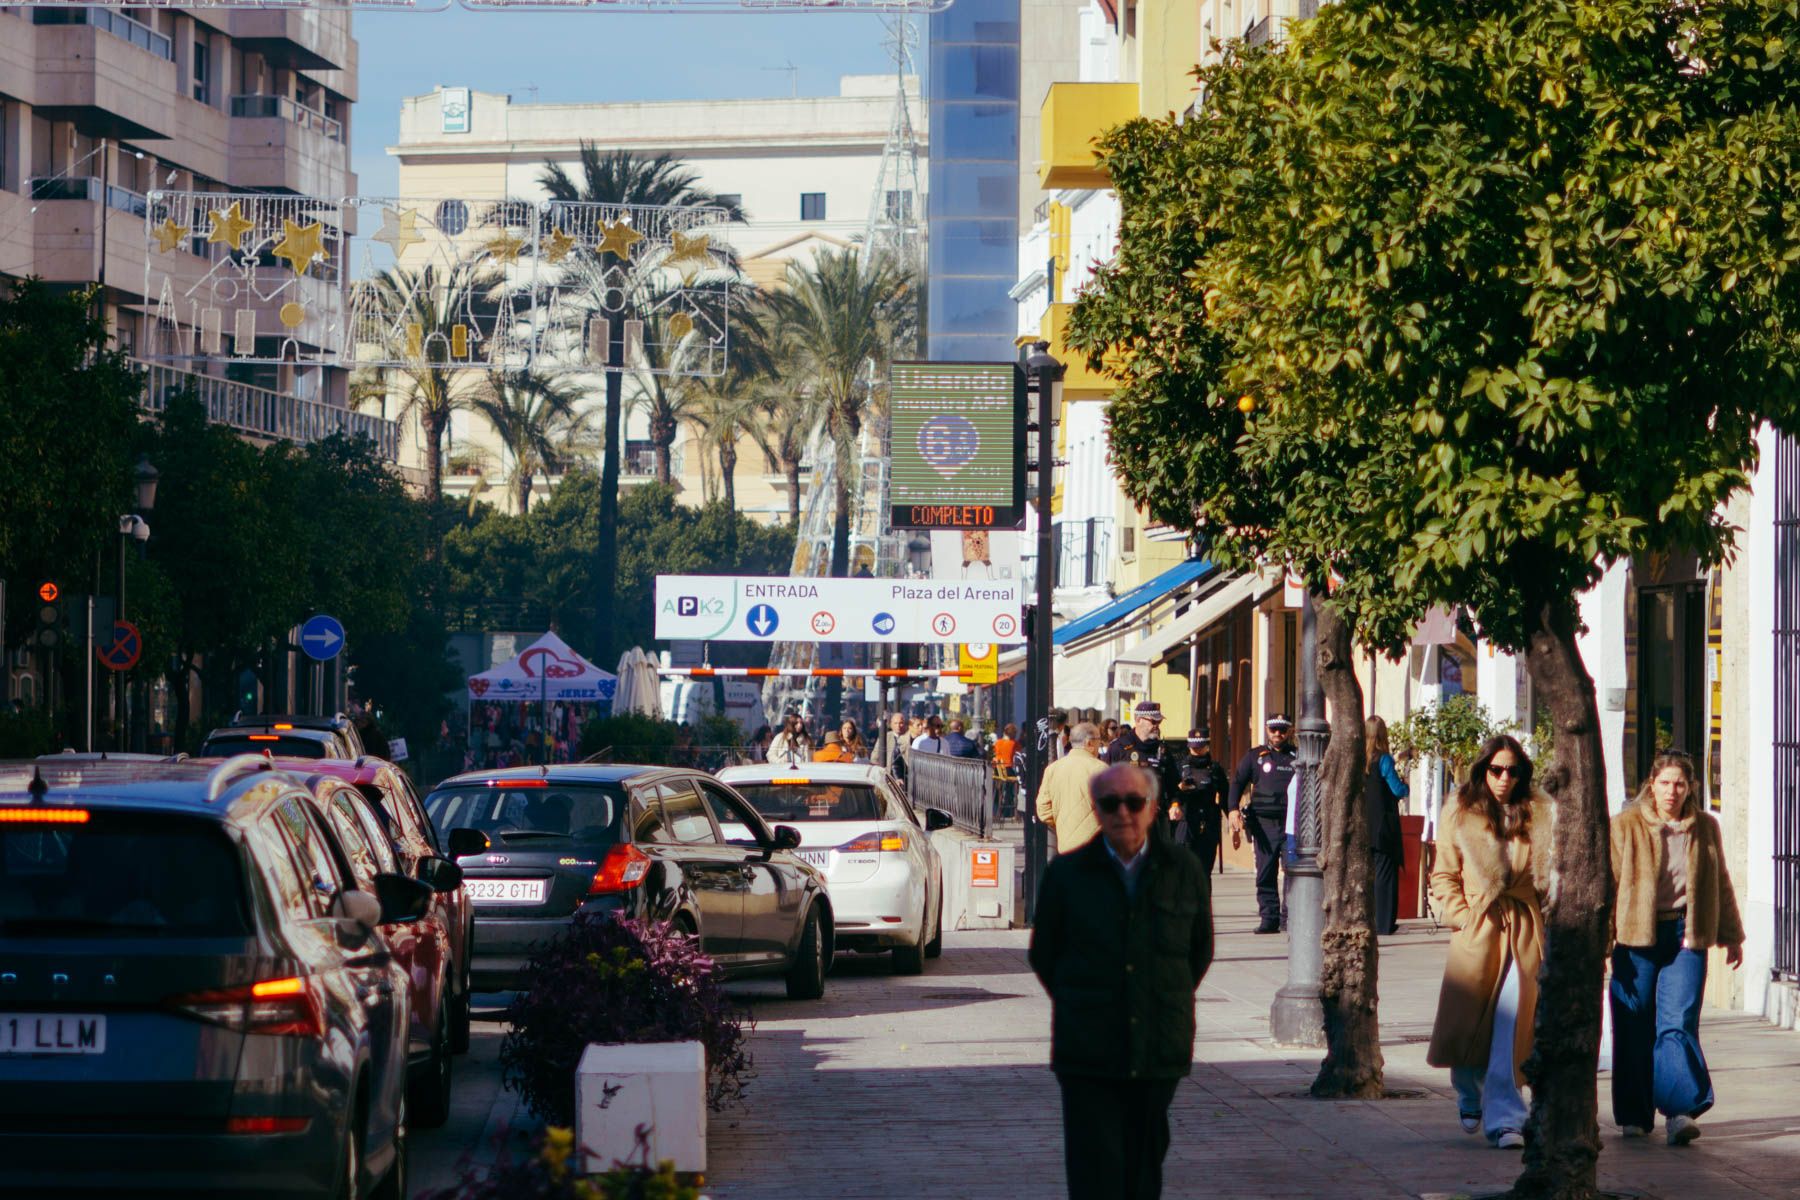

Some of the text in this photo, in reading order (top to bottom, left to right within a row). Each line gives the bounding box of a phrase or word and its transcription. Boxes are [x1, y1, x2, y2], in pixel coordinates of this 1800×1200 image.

[911, 505, 994, 525] COMPLETO
[745, 584, 1014, 601] ENTRADA Plaza del Arenal
[999, 621, 1010, 630] 20
[557, 688, 597, 698] JEREZ
[468, 883, 539, 899] 3232 GTH
[35, 1019, 97, 1049] LLM
